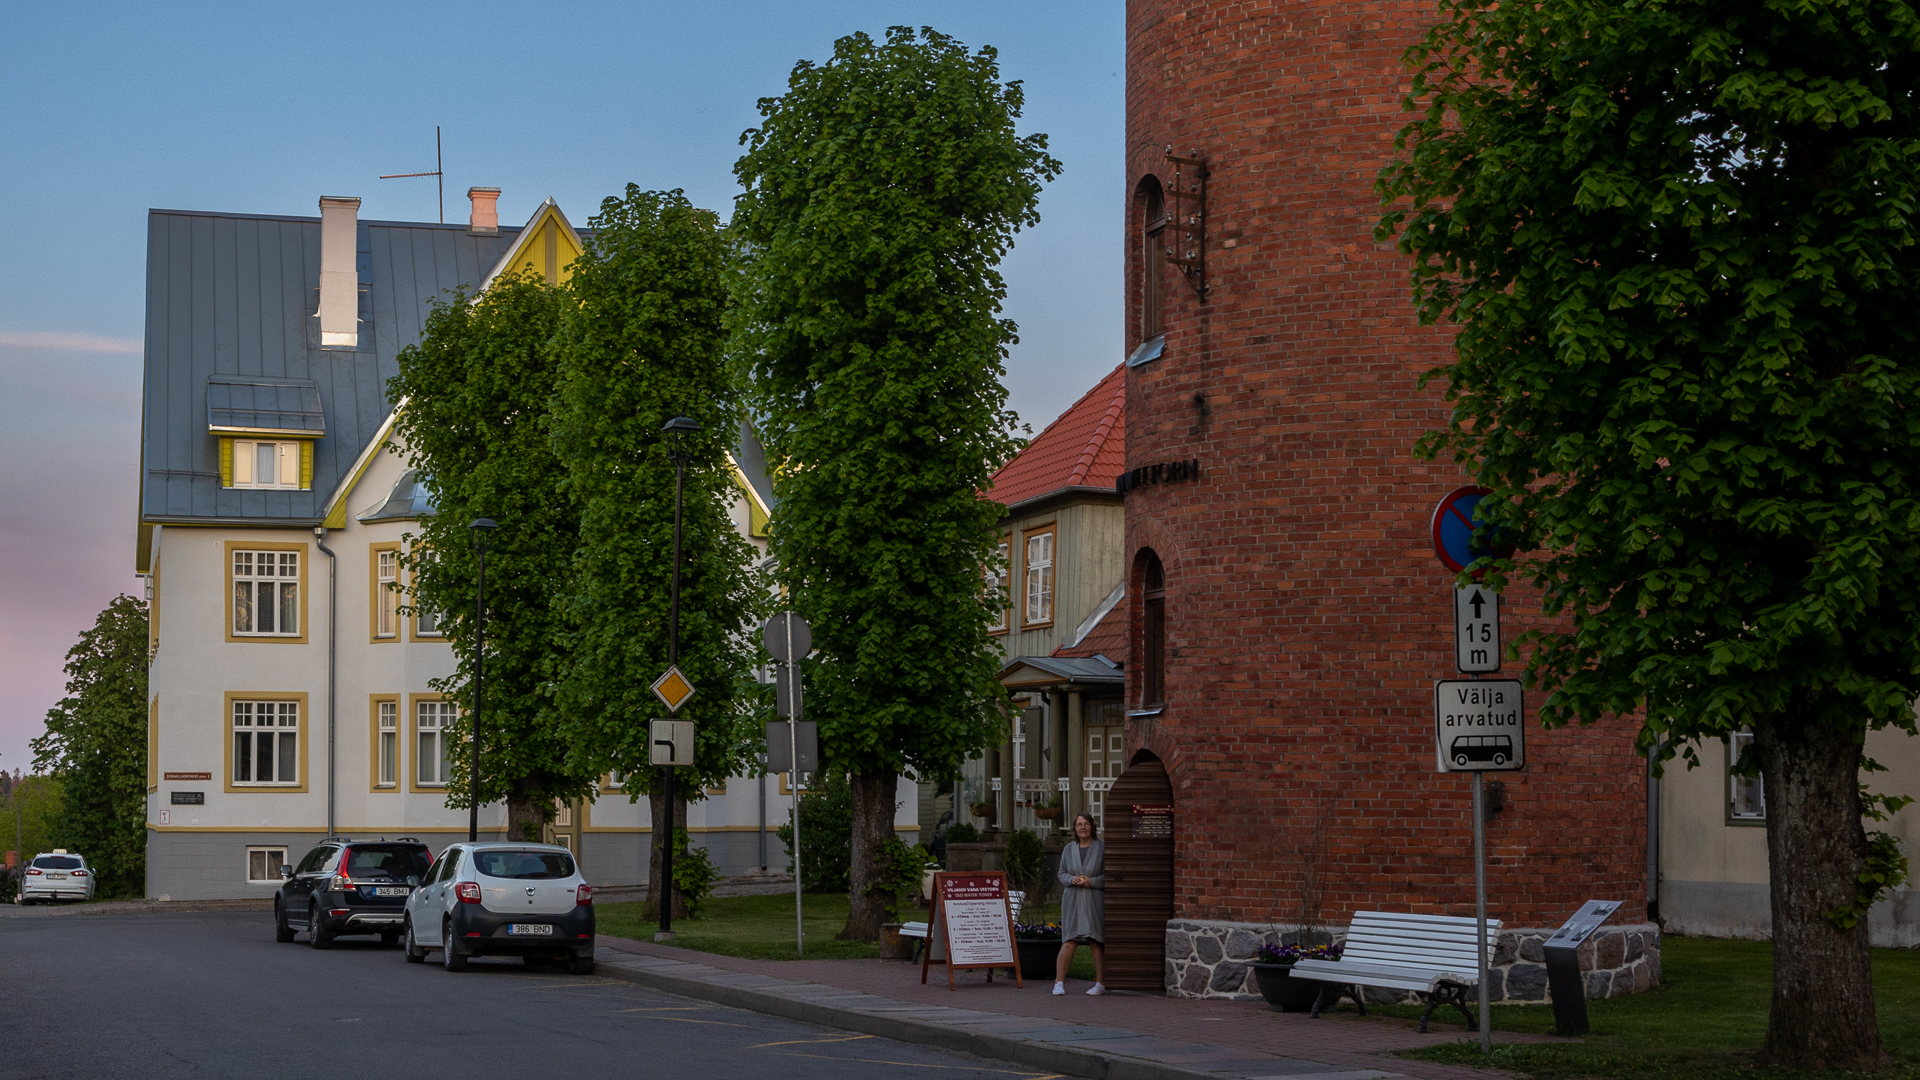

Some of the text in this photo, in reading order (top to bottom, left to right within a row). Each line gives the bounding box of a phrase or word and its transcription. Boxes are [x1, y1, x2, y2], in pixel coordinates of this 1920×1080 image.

[1466, 623, 1491, 642] 15
[1471, 649, 1487, 664] m
[1457, 688, 1504, 708] Välja
[1446, 710, 1516, 726] arvatud
